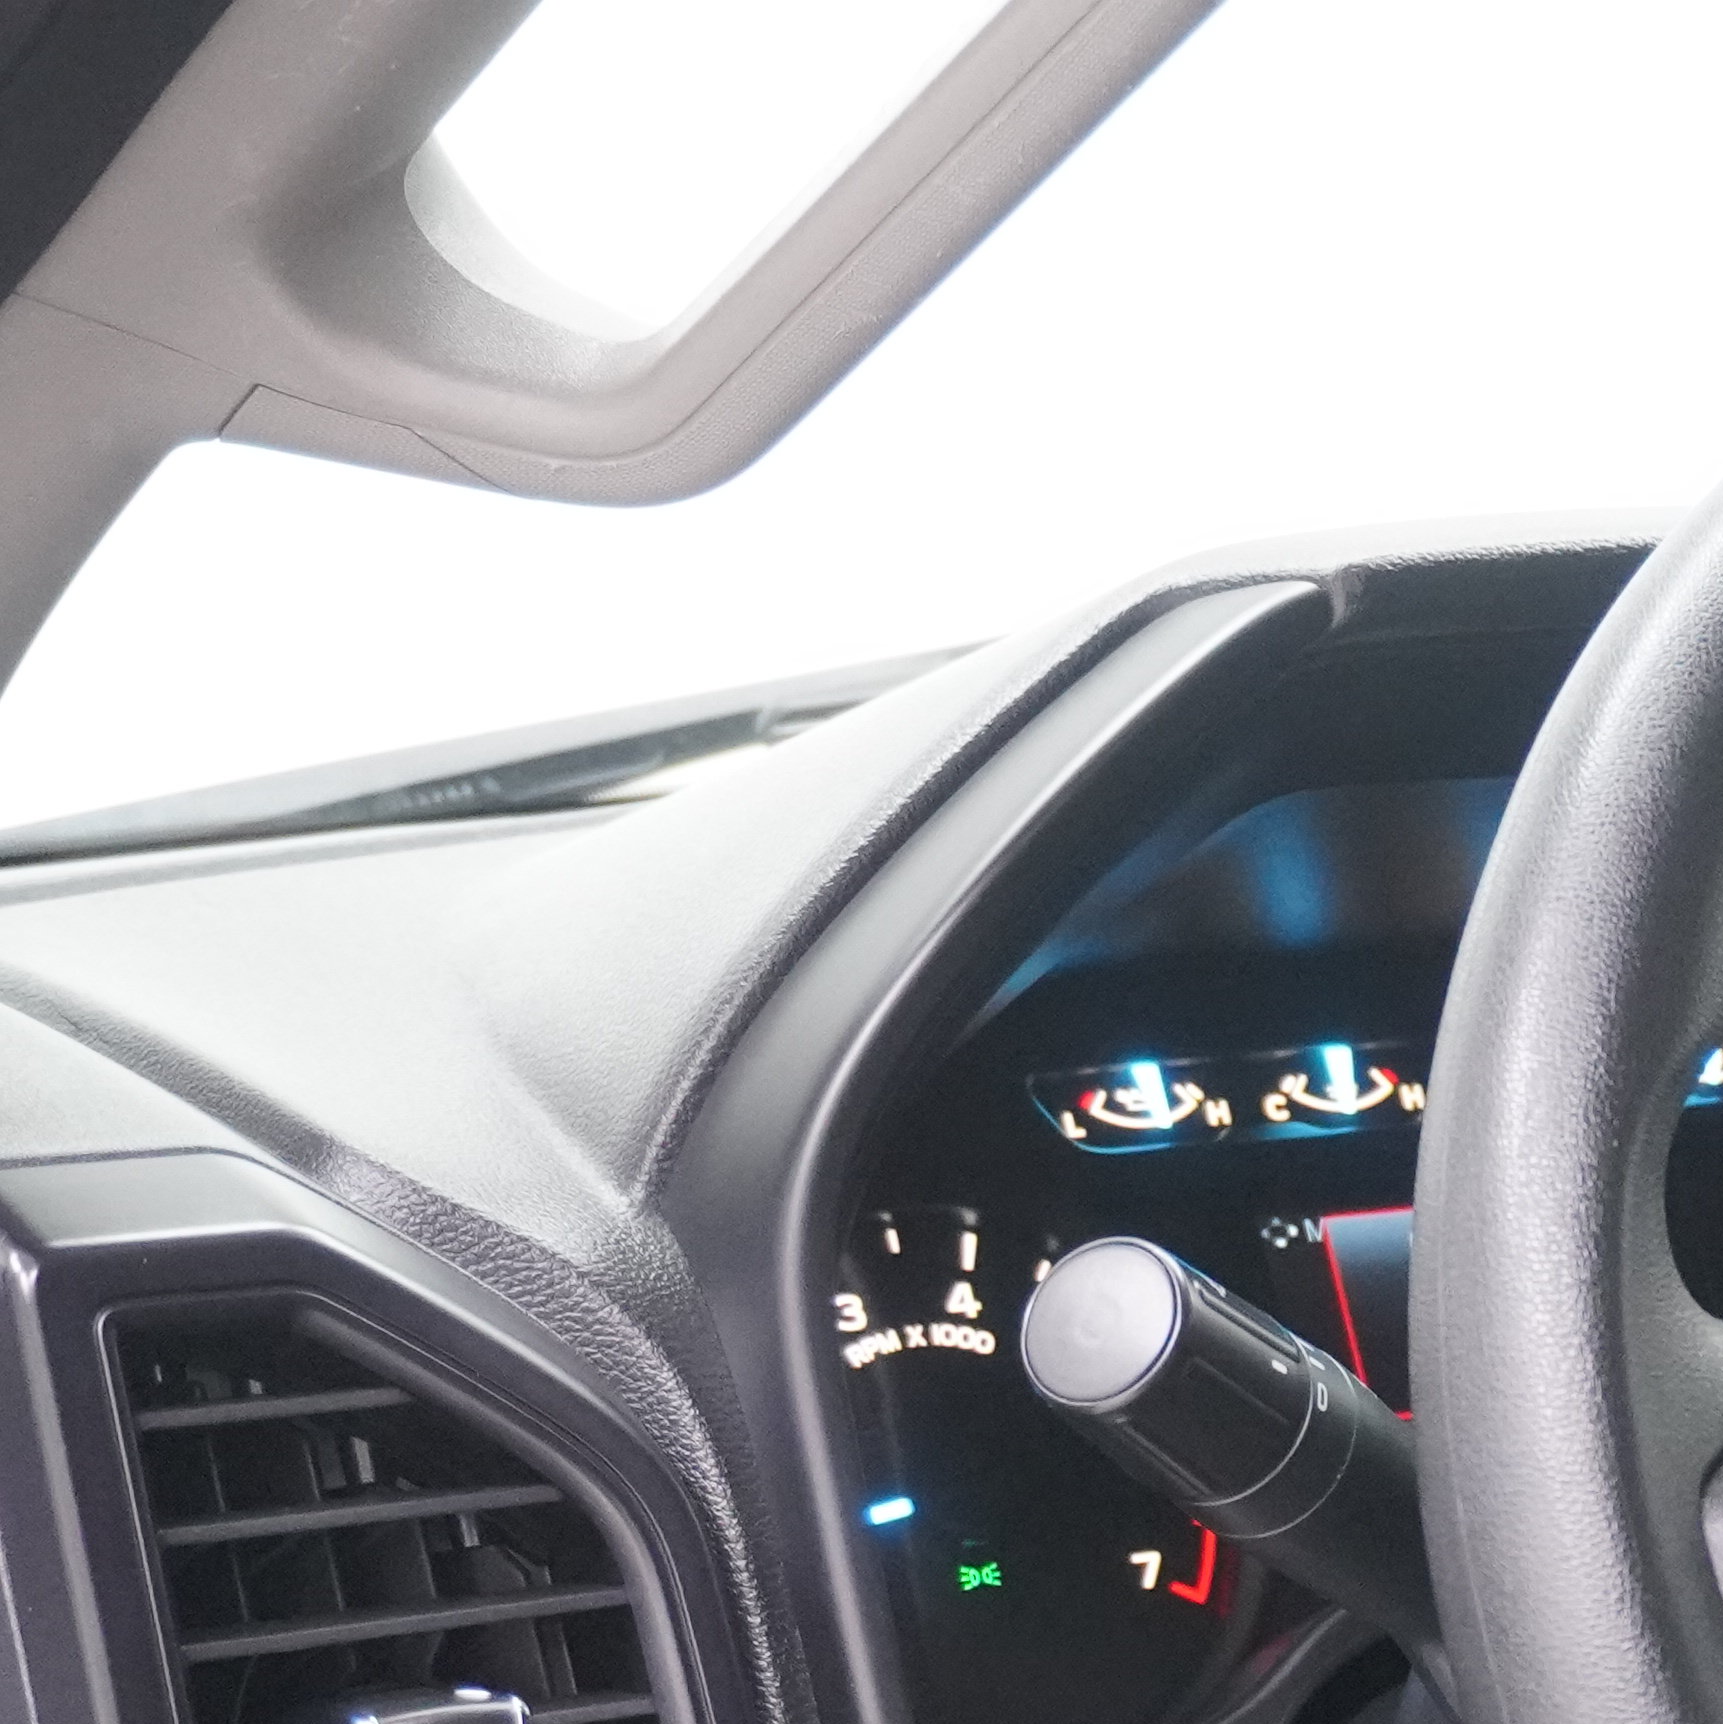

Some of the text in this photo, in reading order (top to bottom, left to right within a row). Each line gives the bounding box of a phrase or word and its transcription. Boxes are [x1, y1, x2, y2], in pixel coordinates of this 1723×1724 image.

[1203, 1098, 1233, 1128] H
[1262, 1092, 1292, 1122] C
[1398, 1082, 1426, 1112] H
[1060, 1110, 1088, 1140] L
[834, 1292, 868, 1332] 3
[944, 1280, 984, 1319] 4
[842, 1327, 903, 1369] RPM
[928, 1322, 997, 1356] 1000
[1129, 1550, 1162, 1590] 7
